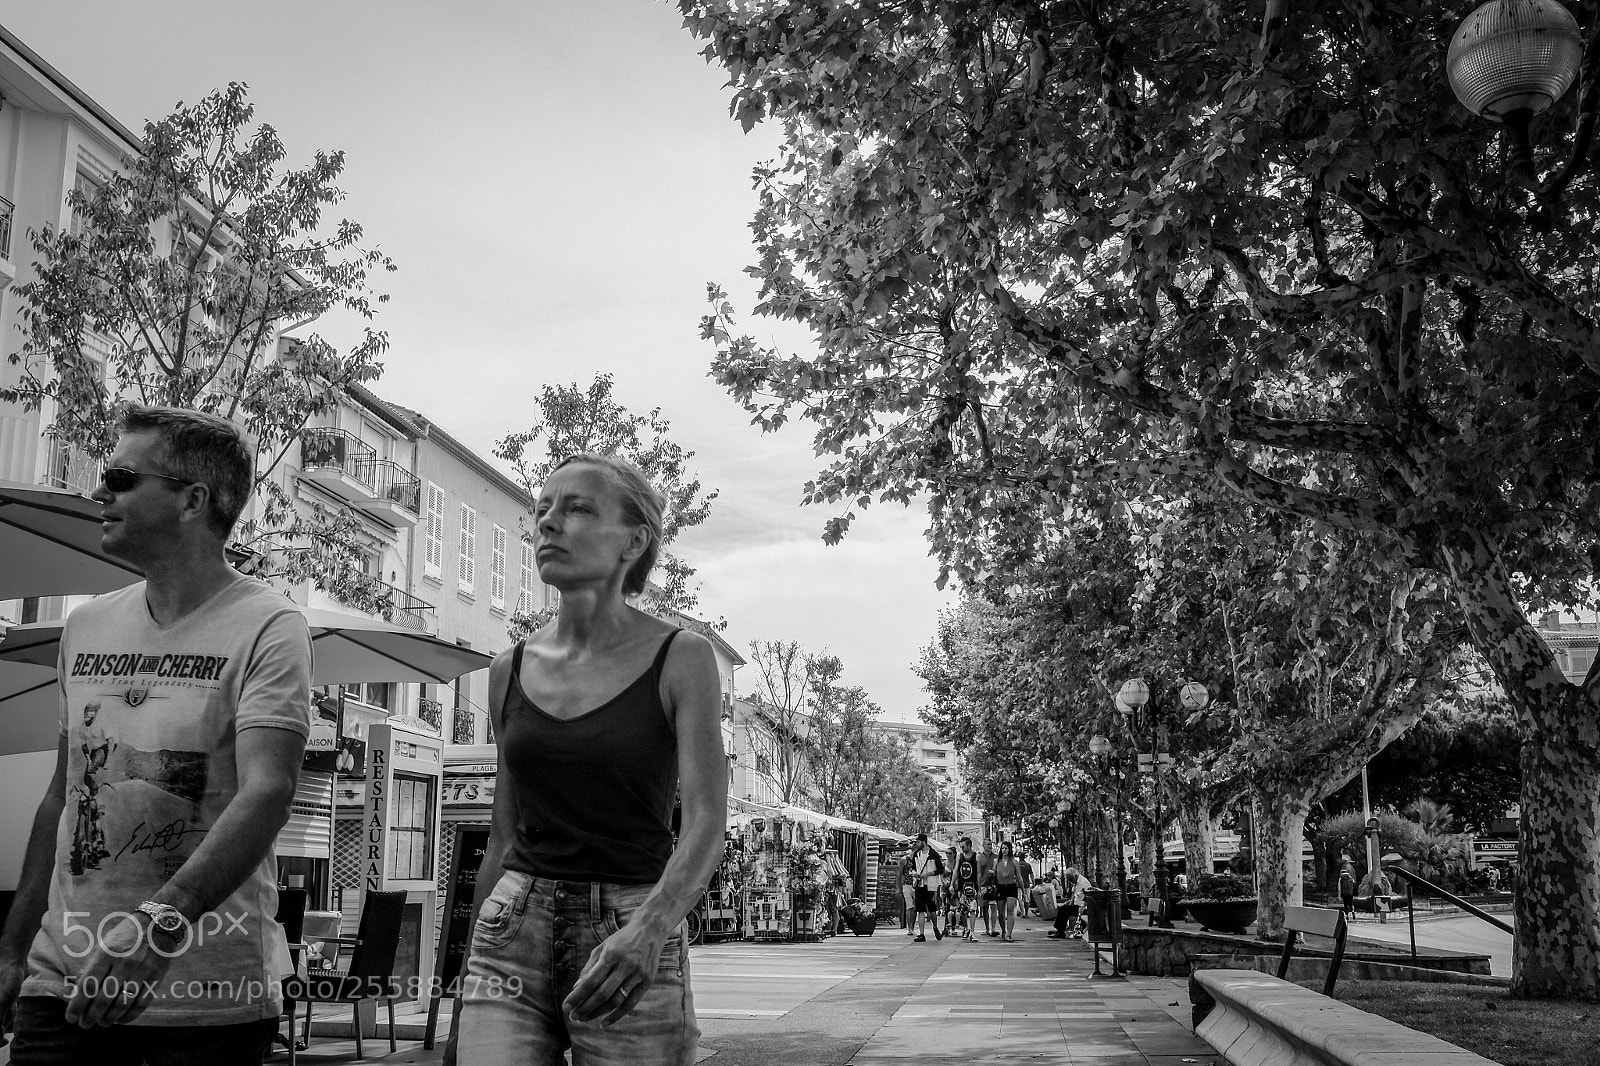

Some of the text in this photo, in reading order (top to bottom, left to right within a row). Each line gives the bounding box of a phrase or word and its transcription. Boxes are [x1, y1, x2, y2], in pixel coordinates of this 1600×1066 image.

[71, 653, 229, 681] BENSON AND CHERRY
[111, 678, 135, 686] True
